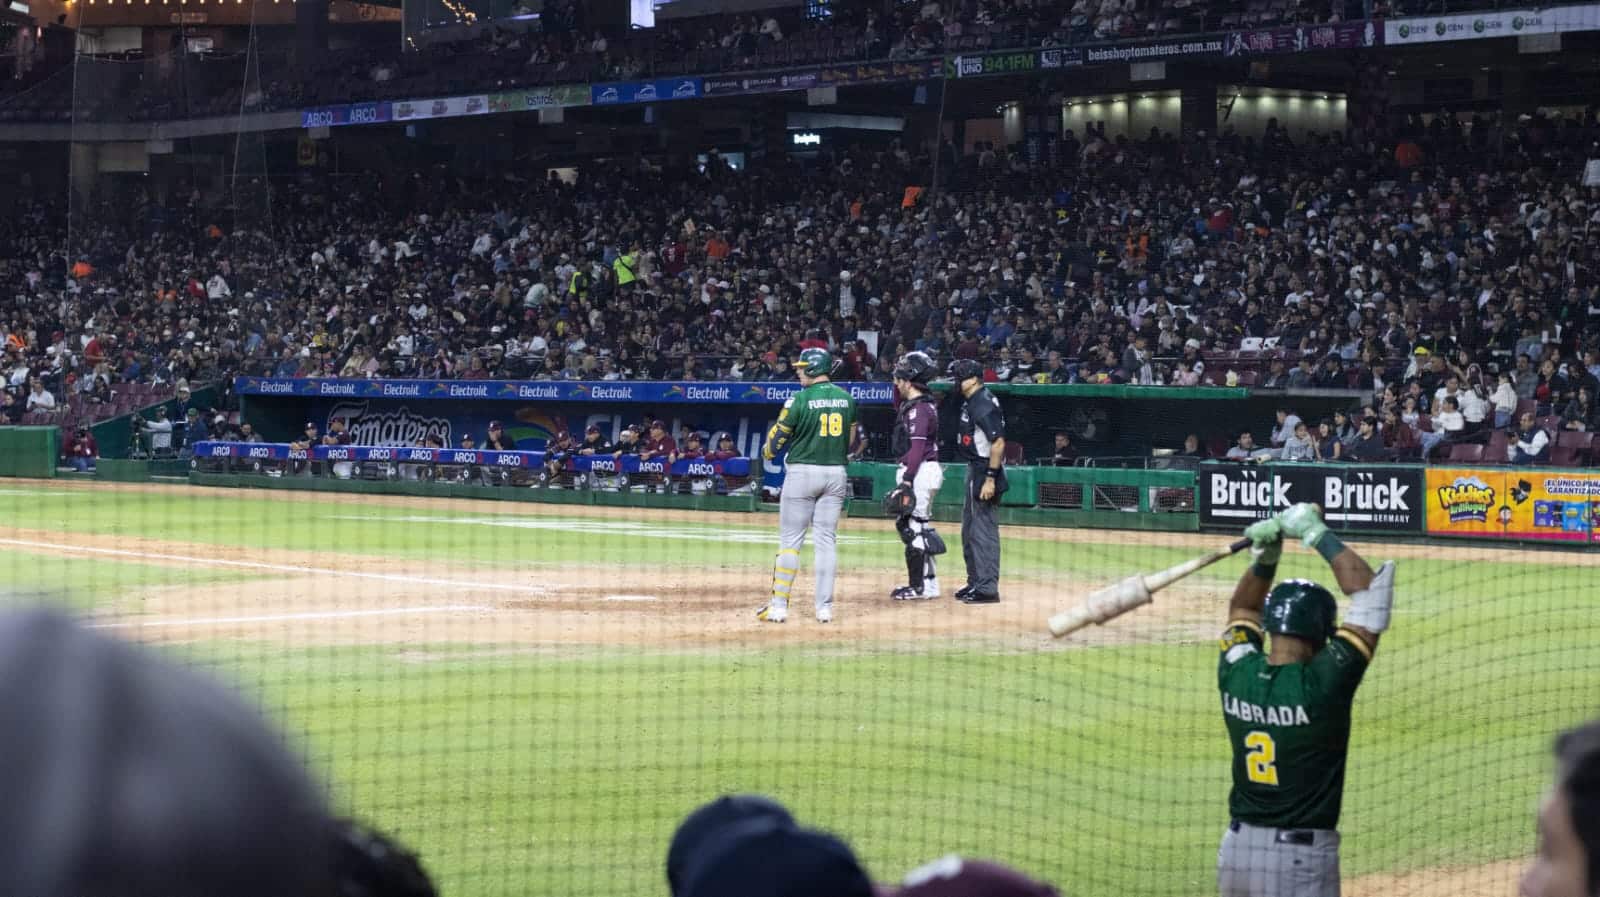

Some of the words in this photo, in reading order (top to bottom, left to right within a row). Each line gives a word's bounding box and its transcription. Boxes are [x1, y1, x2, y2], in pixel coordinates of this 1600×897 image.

[1088, 41, 1222, 61] beisshoptomateros.com.mx
[963, 63, 983, 74] UNO
[307, 111, 333, 125] ARCO
[350, 107, 376, 121] ARCO
[261, 381, 293, 392] Electrolit
[321, 382, 355, 394] Electrolit
[384, 383, 419, 396] Electrolit
[450, 385, 488, 397] Electrolit
[520, 385, 558, 398] Electrolit
[592, 386, 632, 399] Electrolit
[687, 387, 729, 400] Electrolit
[819, 412, 843, 437] 18
[212, 447, 230, 457] ARCO
[250, 448, 268, 458] ARCO
[328, 450, 348, 460] ARCO
[369, 450, 390, 460] ARCO
[411, 450, 432, 461] ARCO
[454, 452, 476, 464] ARCO
[497, 455, 520, 466] ARCO
[592, 461, 615, 471] ARCO
[639, 462, 663, 473] ARCO
[688, 463, 714, 475] ARCO
[1211, 470, 1292, 506] Brück
[1325, 472, 1410, 510] Brück
[1373, 513, 1410, 523] GERMANY
[1272, 605, 1284, 618] 2
[1224, 692, 1311, 726] LABRADA
[1244, 730, 1279, 786] 2
